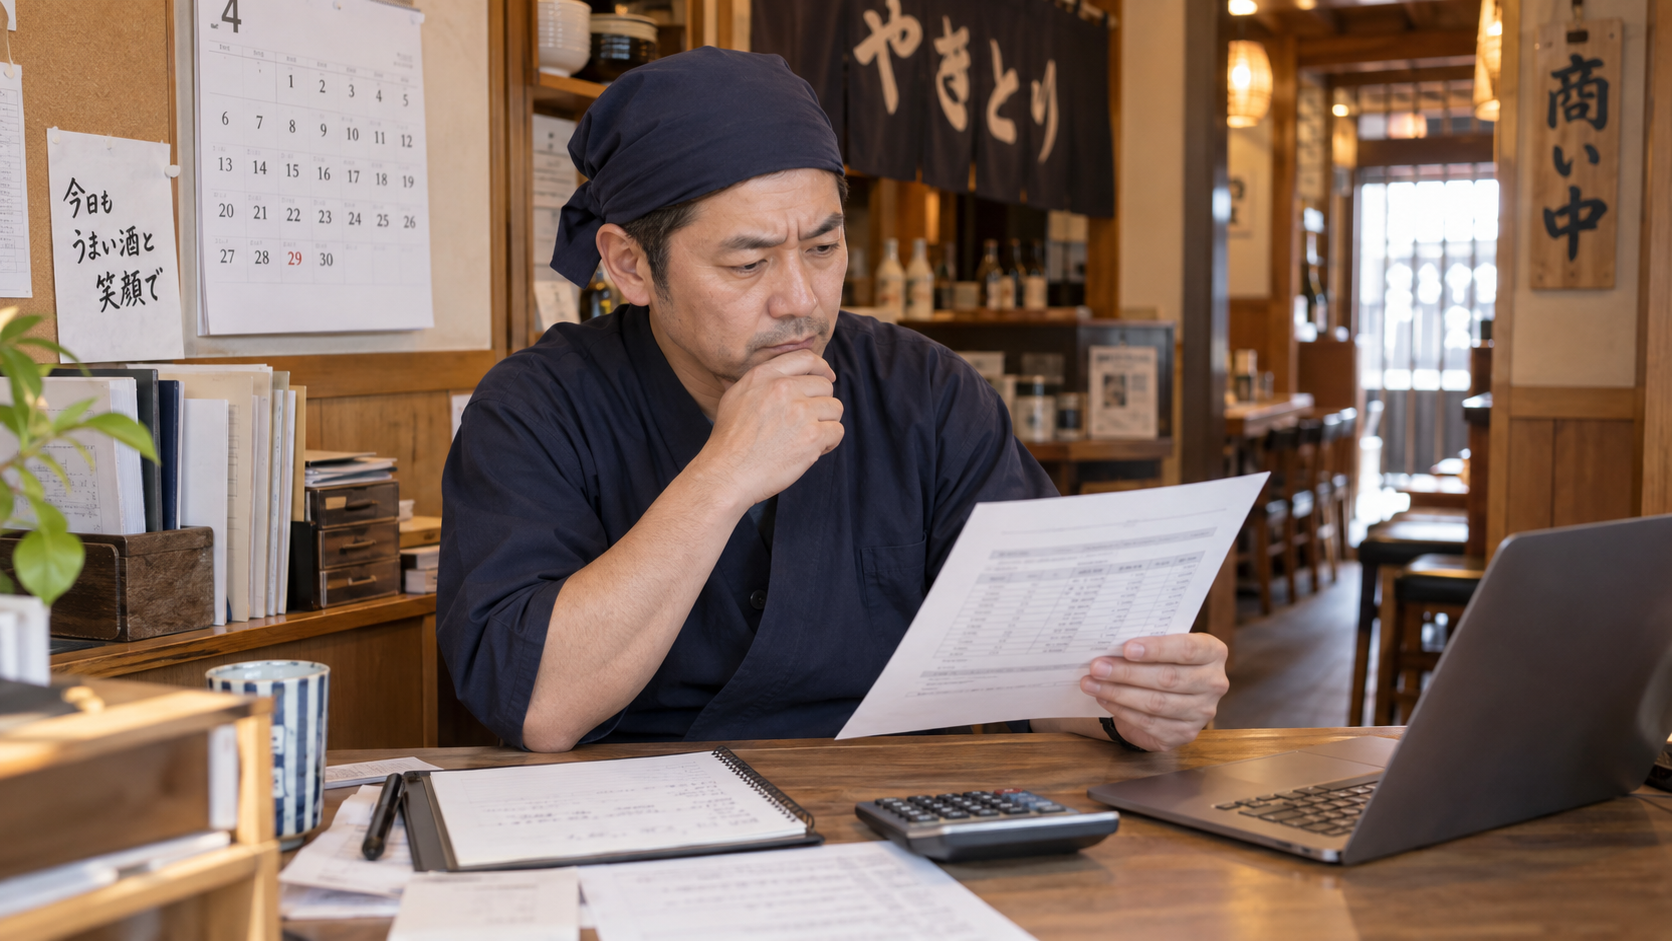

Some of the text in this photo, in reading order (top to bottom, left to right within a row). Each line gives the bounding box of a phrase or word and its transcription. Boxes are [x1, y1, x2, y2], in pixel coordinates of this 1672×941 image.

[221, 0, 242, 34] 4
[288, 74, 409, 108] 1 2 3 4 5
[853, 0, 1059, 164] やきとり
[221, 110, 413, 149] 6 7 8 9 10 11 12
[218, 156, 415, 189] 13 14 15 16 17 18 19
[1543, 53, 1609, 262] 商い中
[63, 177, 113, 218] 今日も
[218, 202, 416, 229] 20 21 22 23 24 25 26
[72, 225, 155, 264] うまい酒と
[220, 248, 334, 267] 27 28 29 30
[96, 267, 164, 313] 笑顔で
